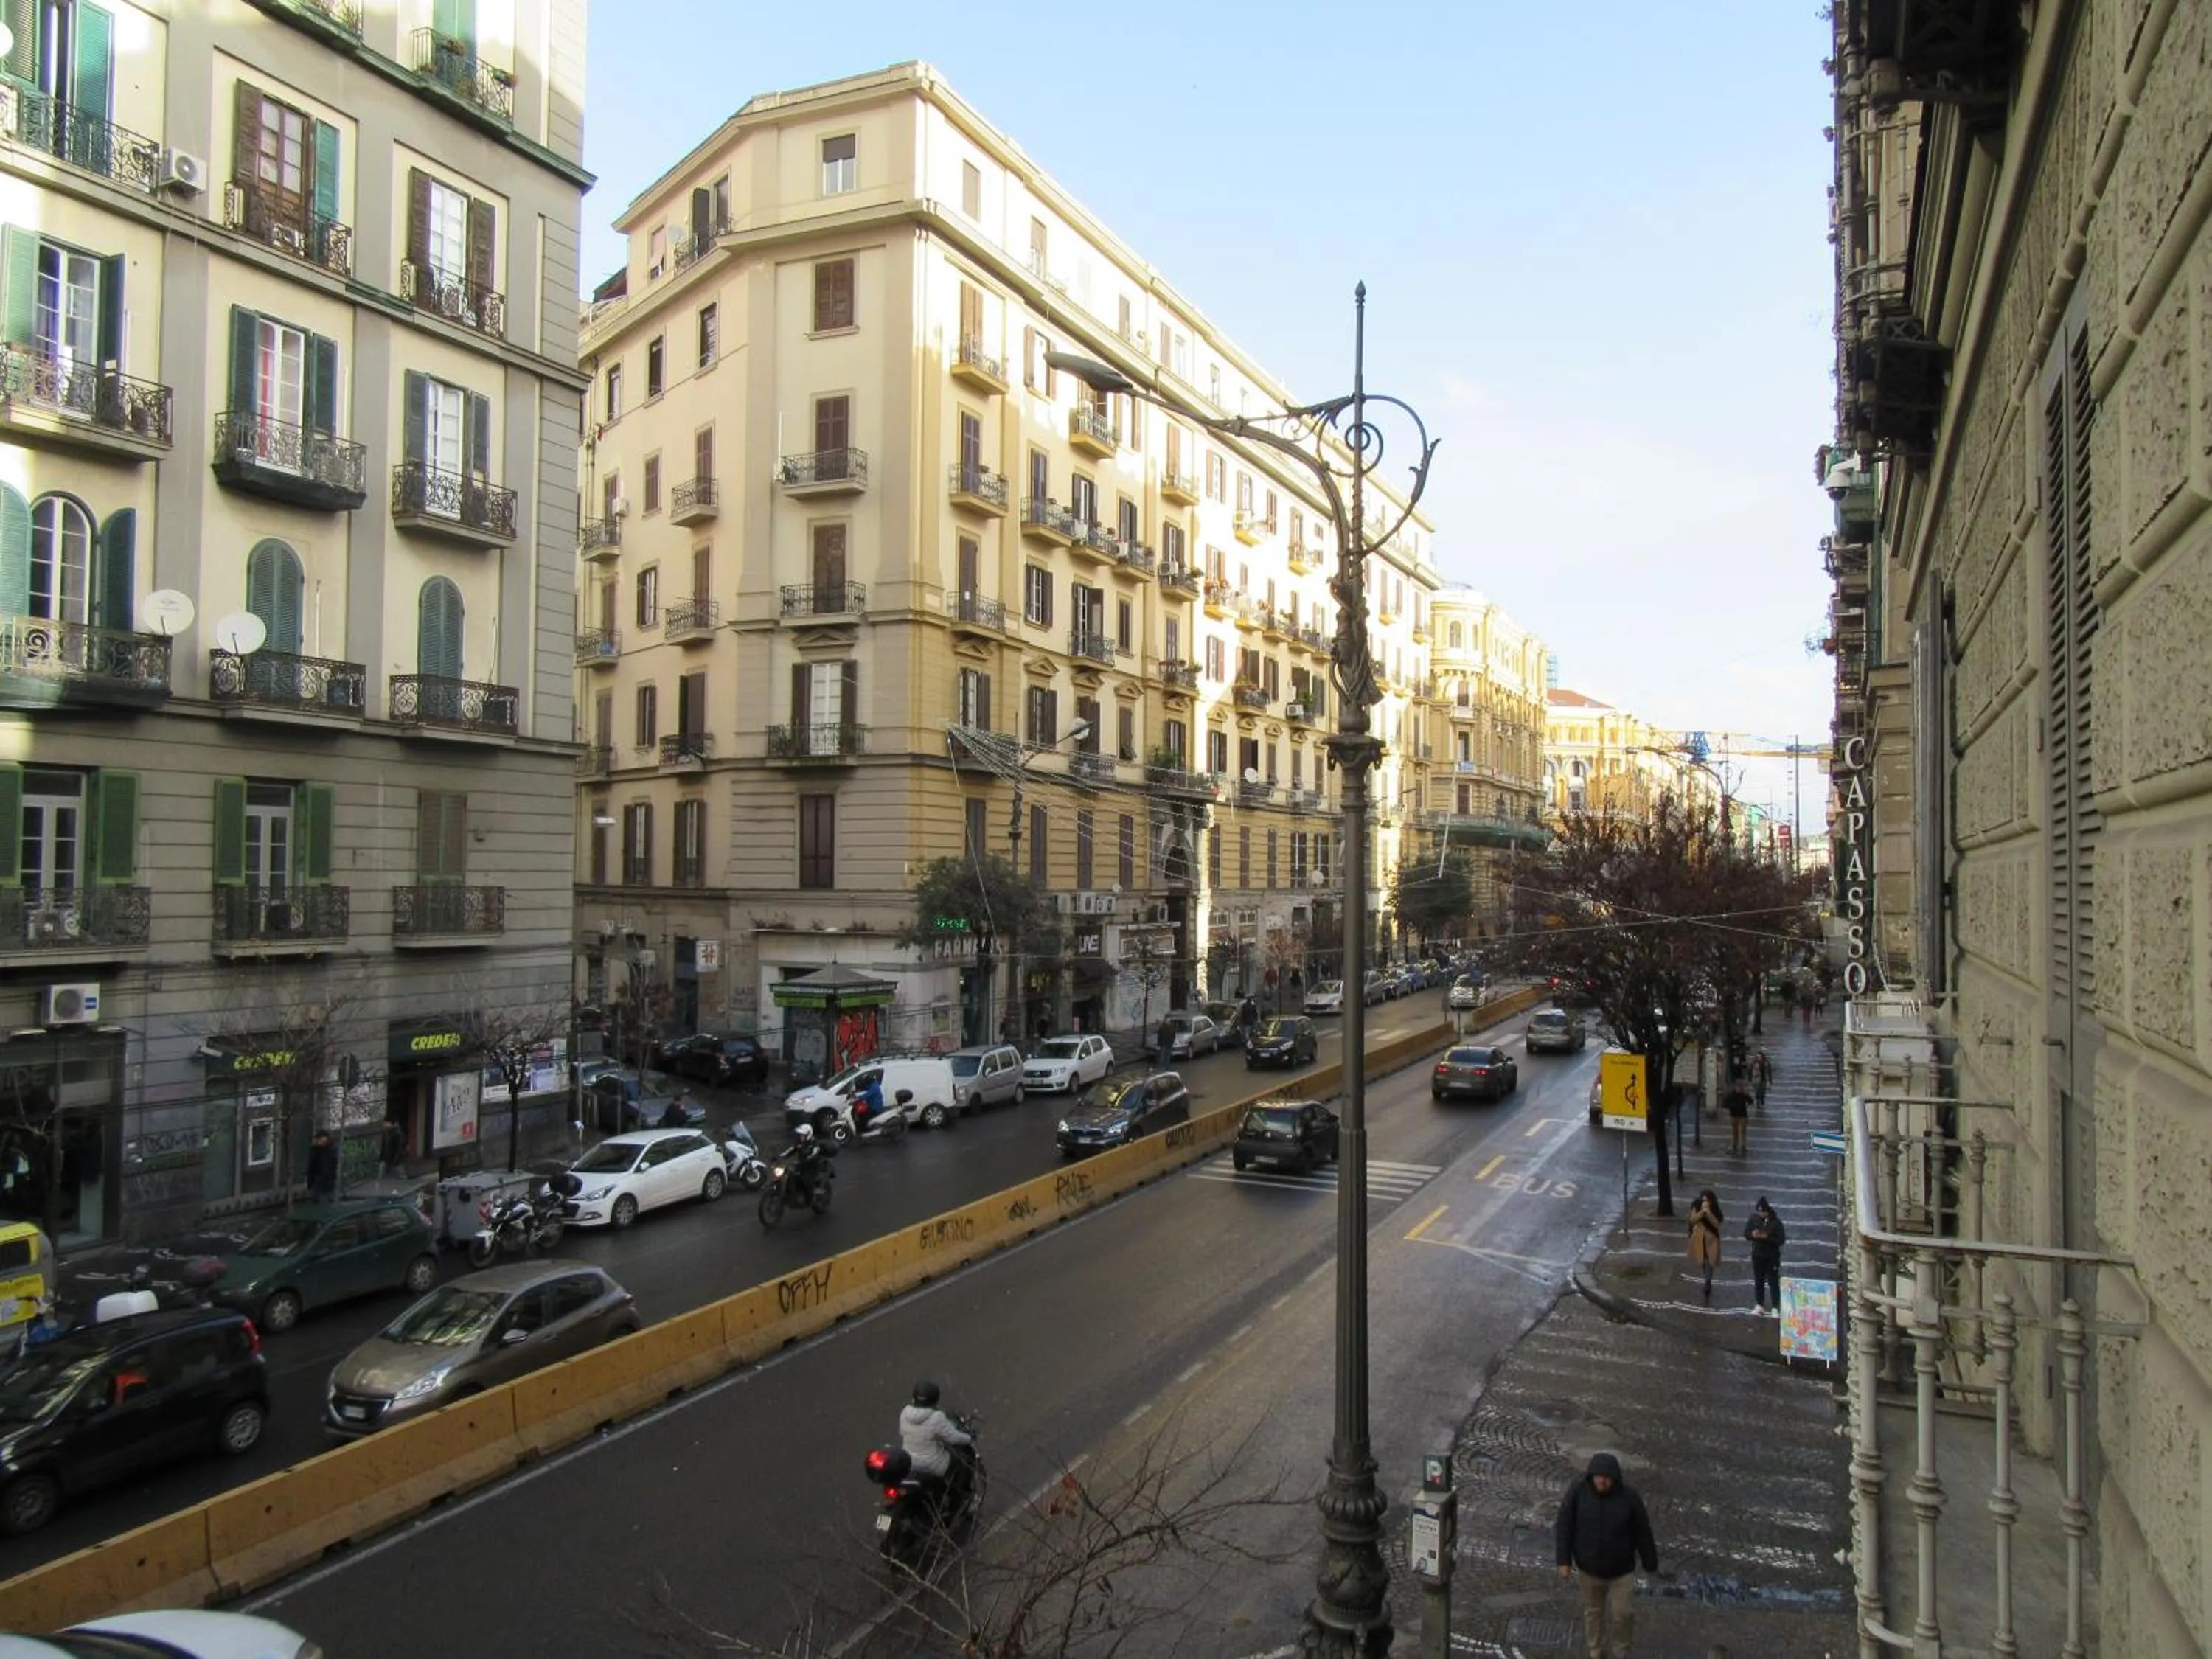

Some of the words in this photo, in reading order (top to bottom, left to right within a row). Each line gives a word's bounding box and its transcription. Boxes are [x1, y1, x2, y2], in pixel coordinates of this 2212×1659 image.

[1845, 737, 1868, 994] CAPASSO
[933, 936, 1004, 959] FARMAIA
[1489, 1172, 1579, 1198] BUS
